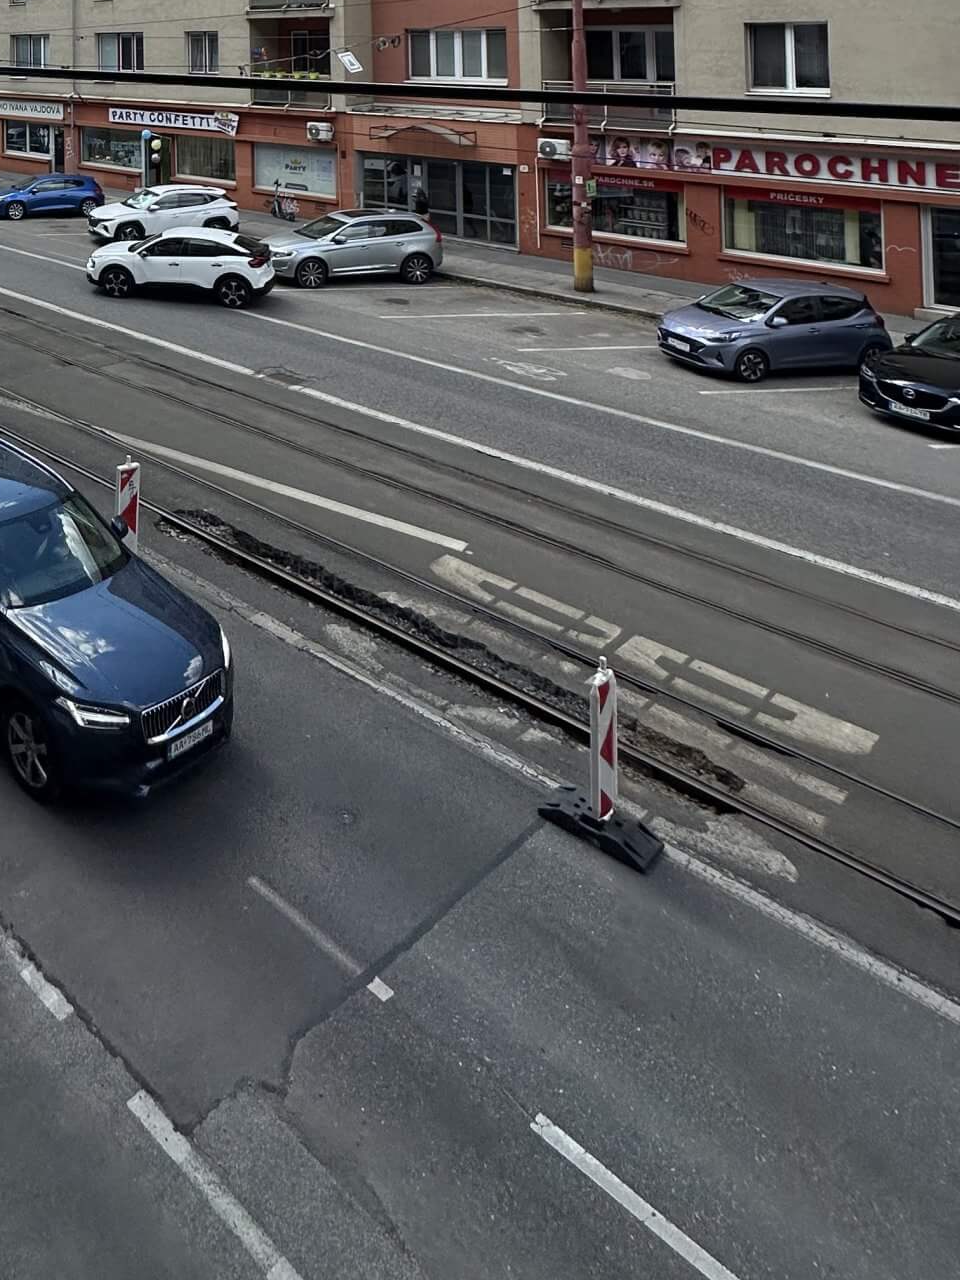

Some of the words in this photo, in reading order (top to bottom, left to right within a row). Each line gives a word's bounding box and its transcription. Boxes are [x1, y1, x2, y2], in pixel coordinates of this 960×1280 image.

[112, 110, 145, 122] PARTY
[149, 112, 210, 128] CONFETTI
[712, 147, 960, 189] PAROCHNE
